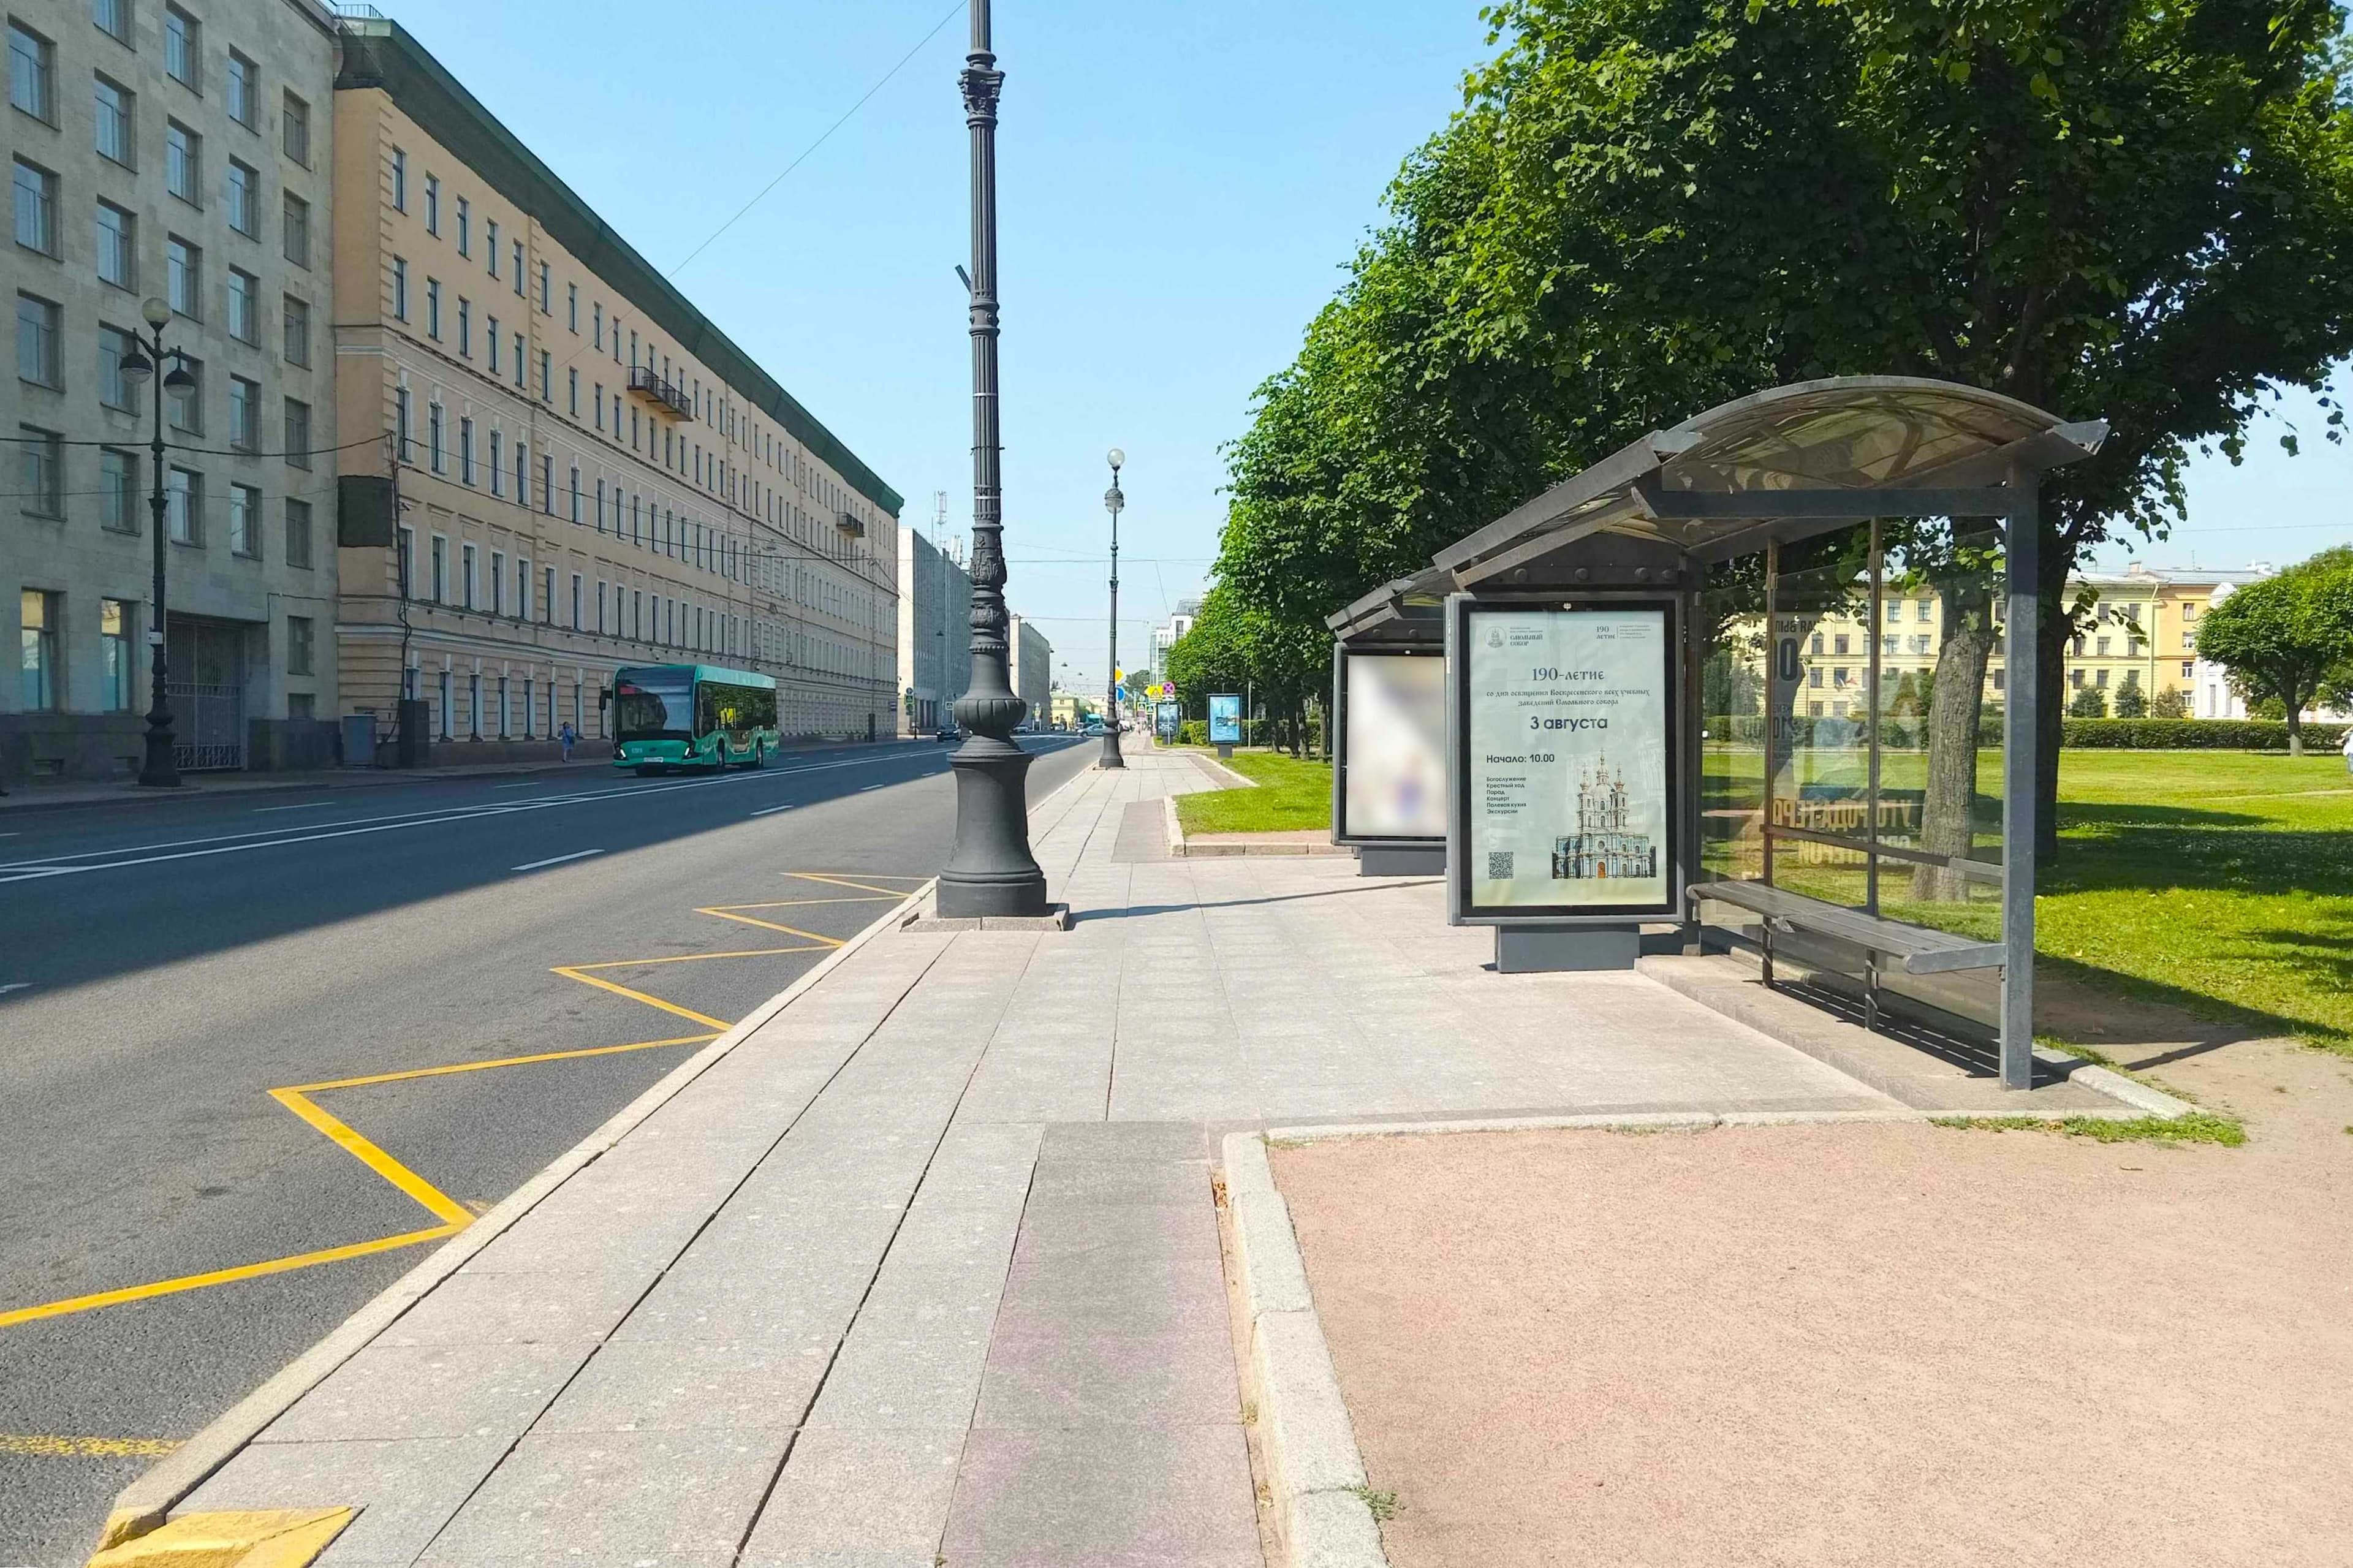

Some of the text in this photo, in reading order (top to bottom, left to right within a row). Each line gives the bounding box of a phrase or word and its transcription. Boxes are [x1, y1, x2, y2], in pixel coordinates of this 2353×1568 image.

[1550, 689, 1602, 697] Воскресенского
[1530, 716, 1608, 732] 3 августа
[1487, 754, 1555, 763] Начало: 10.00
